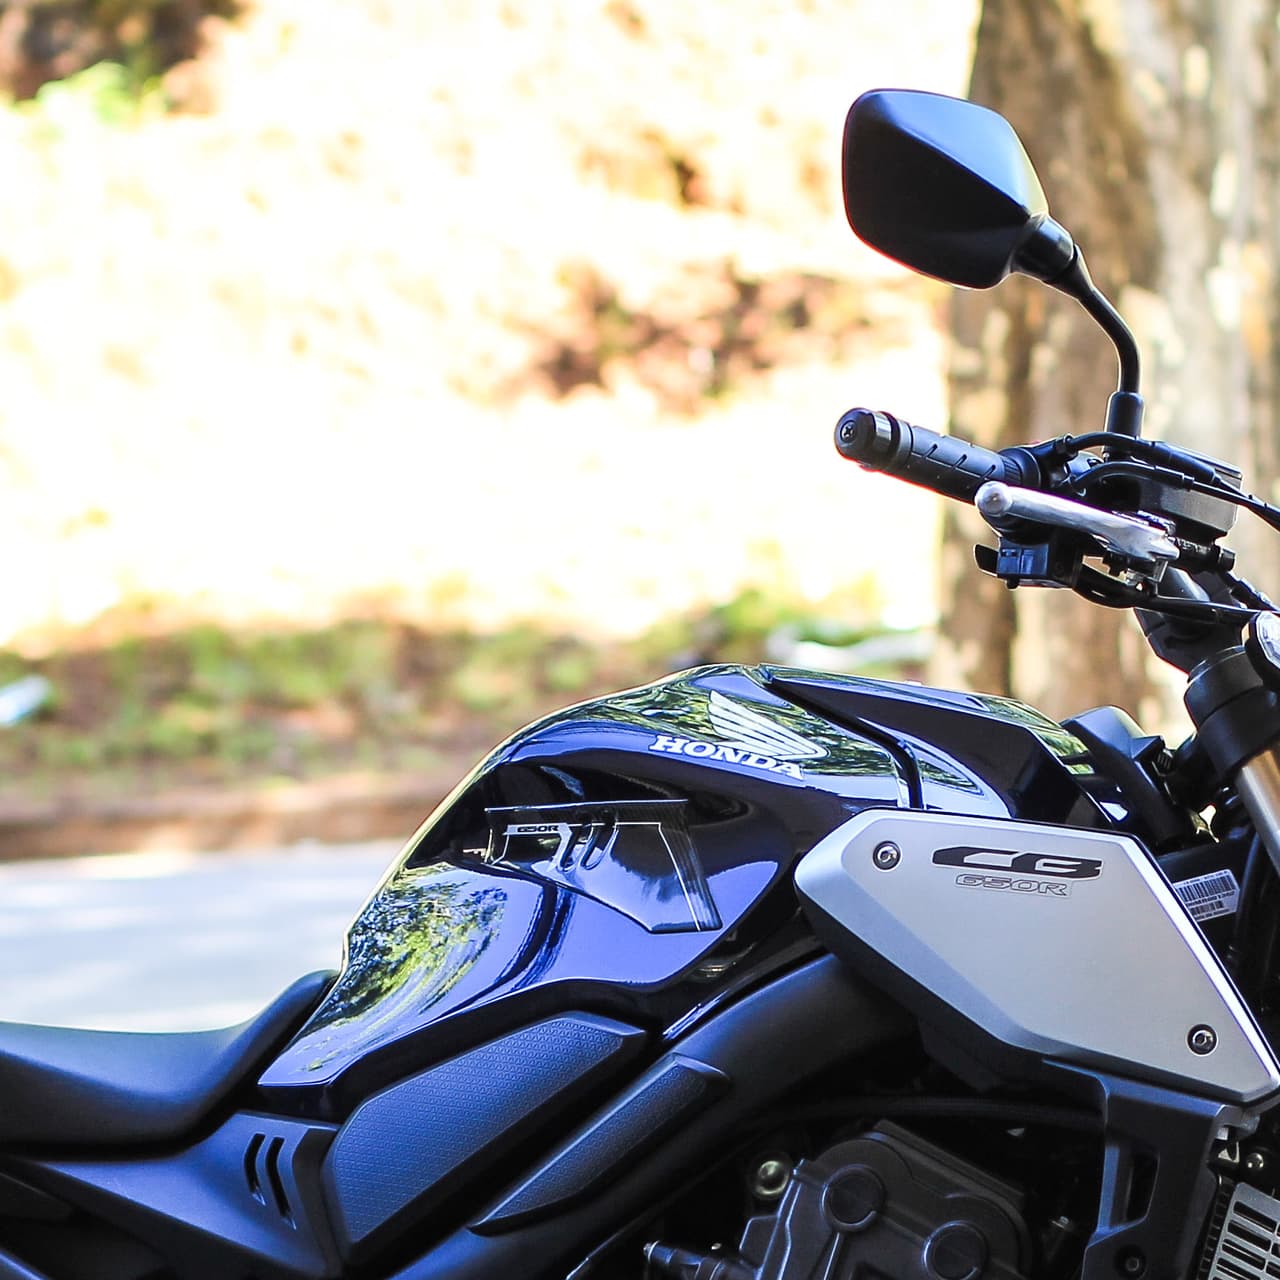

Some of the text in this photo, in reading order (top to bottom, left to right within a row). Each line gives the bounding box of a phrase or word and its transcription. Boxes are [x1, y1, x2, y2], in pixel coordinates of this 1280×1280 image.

[649, 735, 804, 781] HONDA
[932, 845, 1103, 879] CB
[955, 873, 1068, 896] 650R
